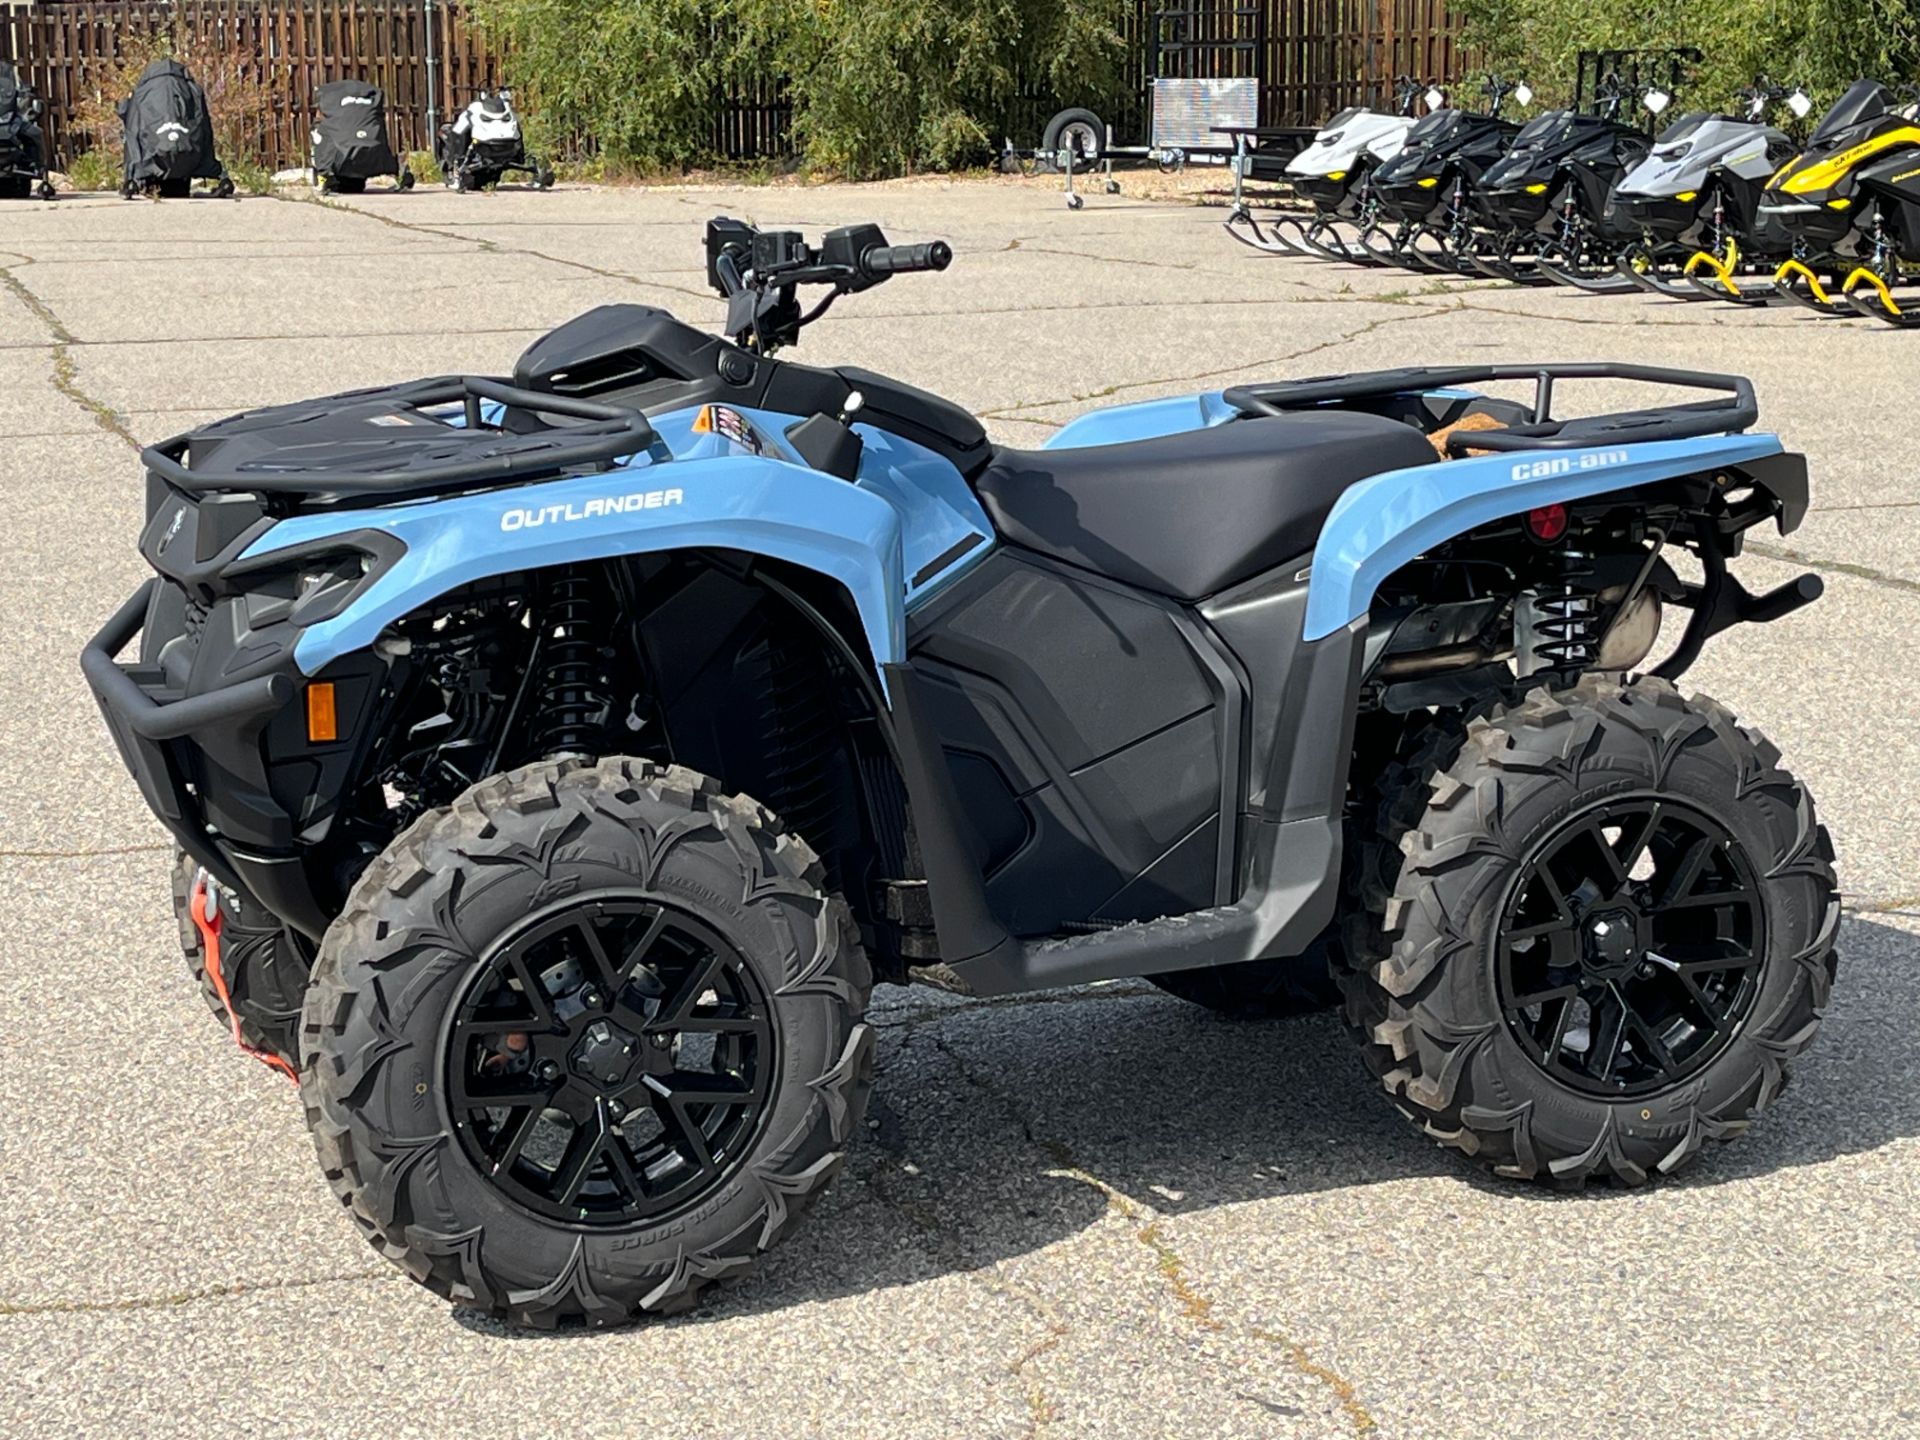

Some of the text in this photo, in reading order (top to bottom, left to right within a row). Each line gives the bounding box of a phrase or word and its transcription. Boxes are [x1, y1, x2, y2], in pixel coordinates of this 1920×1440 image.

[1511, 449, 1629, 481] can-am
[500, 487, 684, 532] OUTLANDER
[609, 1221, 686, 1252] FORCE
